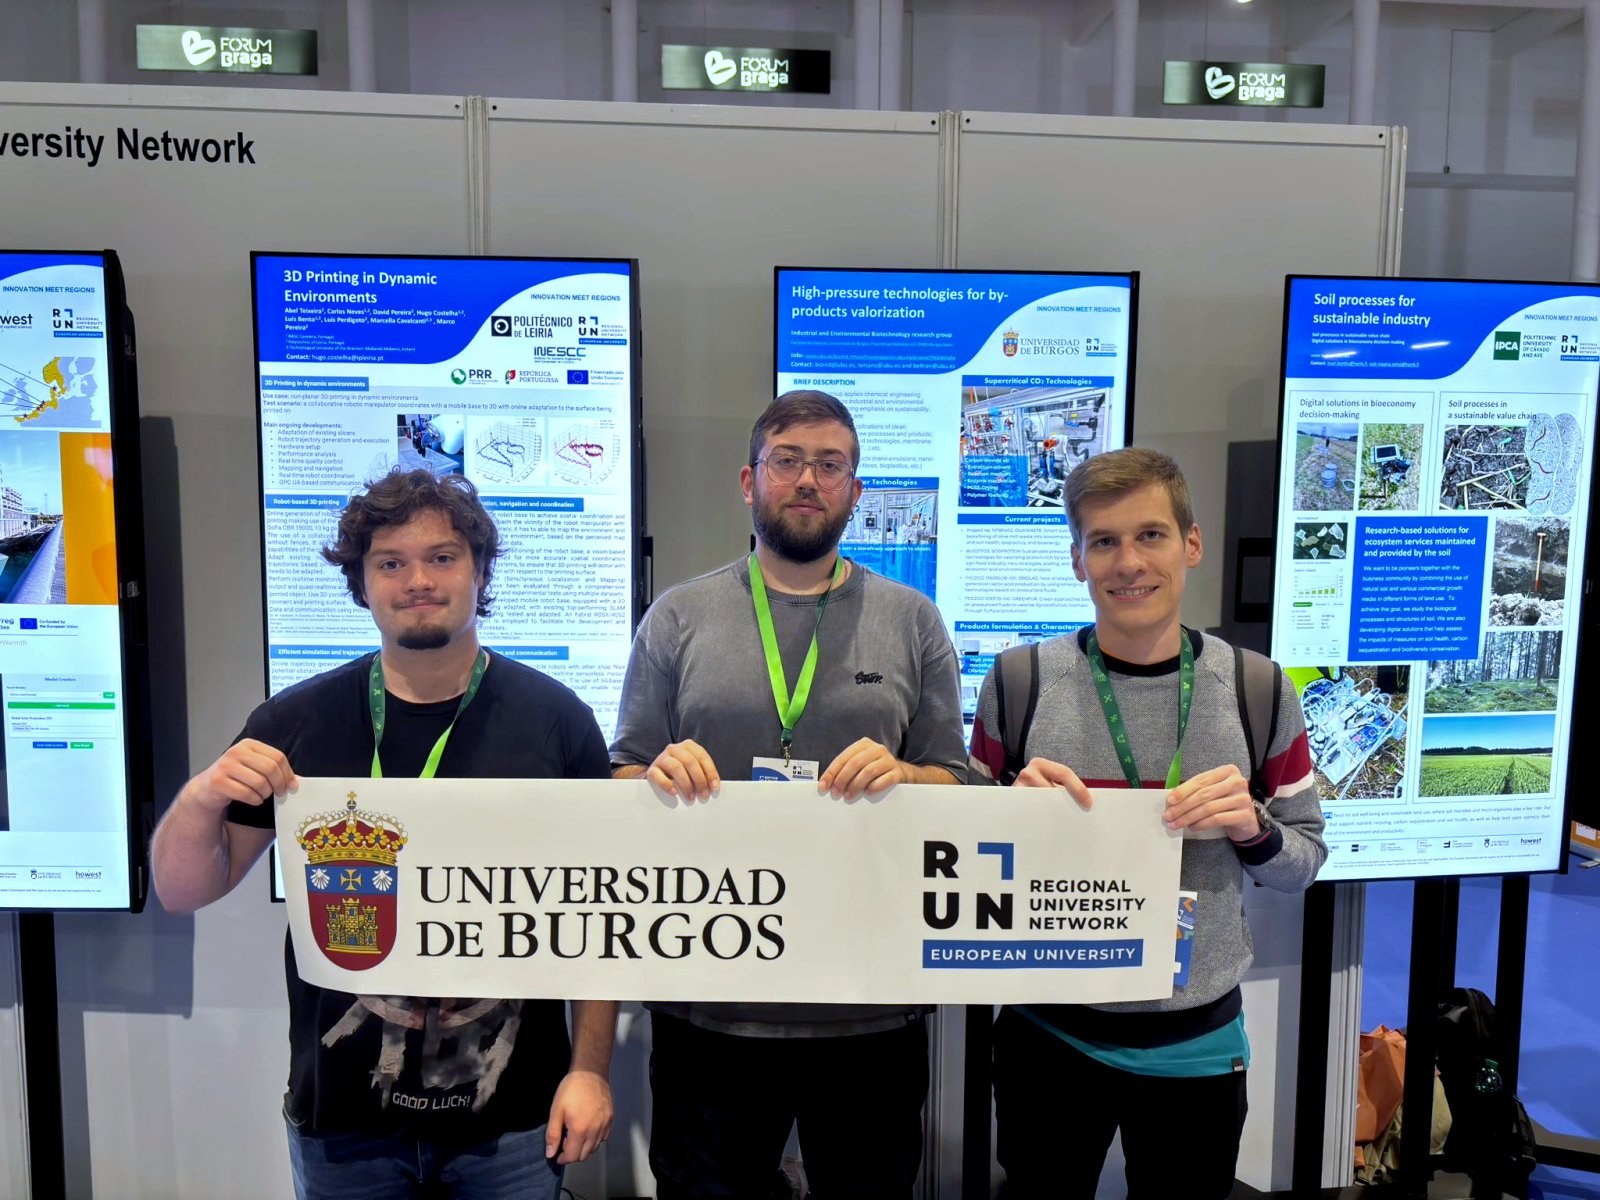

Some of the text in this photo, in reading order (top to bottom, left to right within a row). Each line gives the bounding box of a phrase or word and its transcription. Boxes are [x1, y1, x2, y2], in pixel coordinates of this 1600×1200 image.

[220, 37, 272, 52] FORUM
[220, 52, 272, 68] Braga
[741, 57, 789, 72] FORUM
[741, 71, 789, 87] Braga
[1239, 73, 1285, 86] FORUM
[1238, 86, 1285, 101] Braga
[117, 127, 256, 164] Network
[283, 270, 437, 286] 3D Printing in Dynamic
[285, 290, 377, 303] Environments
[792, 286, 1008, 302] High-pressure technologies for by-
[1314, 293, 1415, 307] Soil processes for
[792, 305, 925, 319] products valorization
[514, 314, 573, 327] POLITÉCNICO
[1313, 312, 1430, 328] sustainable industry
[524, 328, 553, 338] LEIRIA
[1020, 338, 1080, 346] UNIVERSIDAD
[1495, 341, 1518, 350] IPCA
[534, 346, 586, 357] INESCC
[1020, 346, 1080, 355] DE BURGOS
[469, 369, 492, 379] PRR
[1046, 378, 1092, 386] Technologies
[1300, 399, 1324, 407] Digital
[1326, 399, 1360, 407] solutions
[1370, 400, 1416, 408] bioeconomy
[1448, 400, 1462, 408] Soil
[1299, 411, 1360, 419] decision-making
[1518, 412, 1537, 420] chain
[1033, 516, 1061, 524] projects
[1365, 526, 1469, 534] Research-based solutions for
[1364, 538, 1402, 547] ecosystem
[1435, 537, 1476, 545] maintained
[1364, 549, 1378, 557] and
[1379, 549, 1412, 558] provided
[1414, 549, 1422, 558] by
[923, 840, 959, 879] R
[416, 866, 786, 906] UNIVERSIDAD
[1030, 879, 1131, 893] REGIONAL
[1029, 898, 1146, 912] UNIVERSITY
[1029, 917, 1128, 930] NETWORK
[416, 912, 786, 961] DE BURGOS
[930, 948, 1136, 961] EUROPEAN UNIVERSITY
[392, 1092, 471, 1110] GOOD LUCK!
